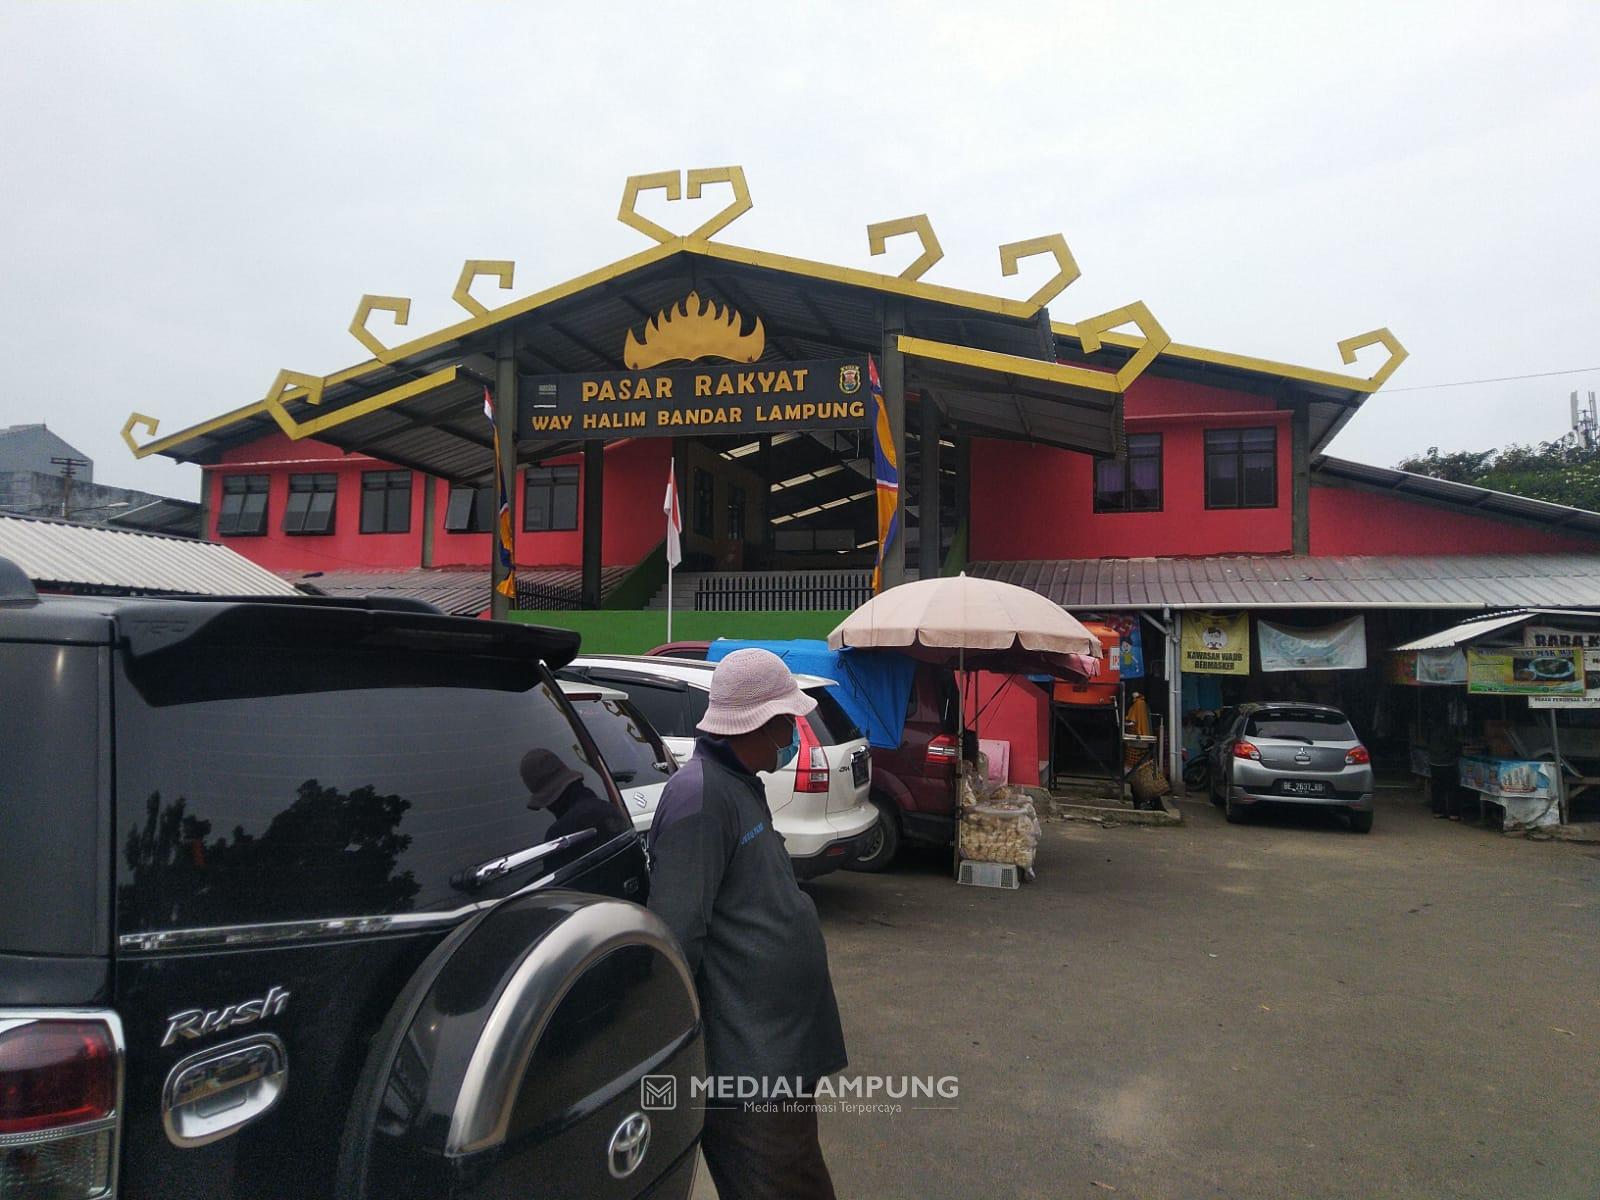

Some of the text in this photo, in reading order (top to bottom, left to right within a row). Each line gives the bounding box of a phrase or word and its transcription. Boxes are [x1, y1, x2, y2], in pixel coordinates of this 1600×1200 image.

[582, 376, 673, 402] PASAR
[695, 369, 809, 397] RAKYAT
[532, 401, 865, 431] WAY HALIM BANDAR LAMPUNG
[1187, 651, 1220, 661] KAWASAN
[161, 986, 290, 1047] Rush
